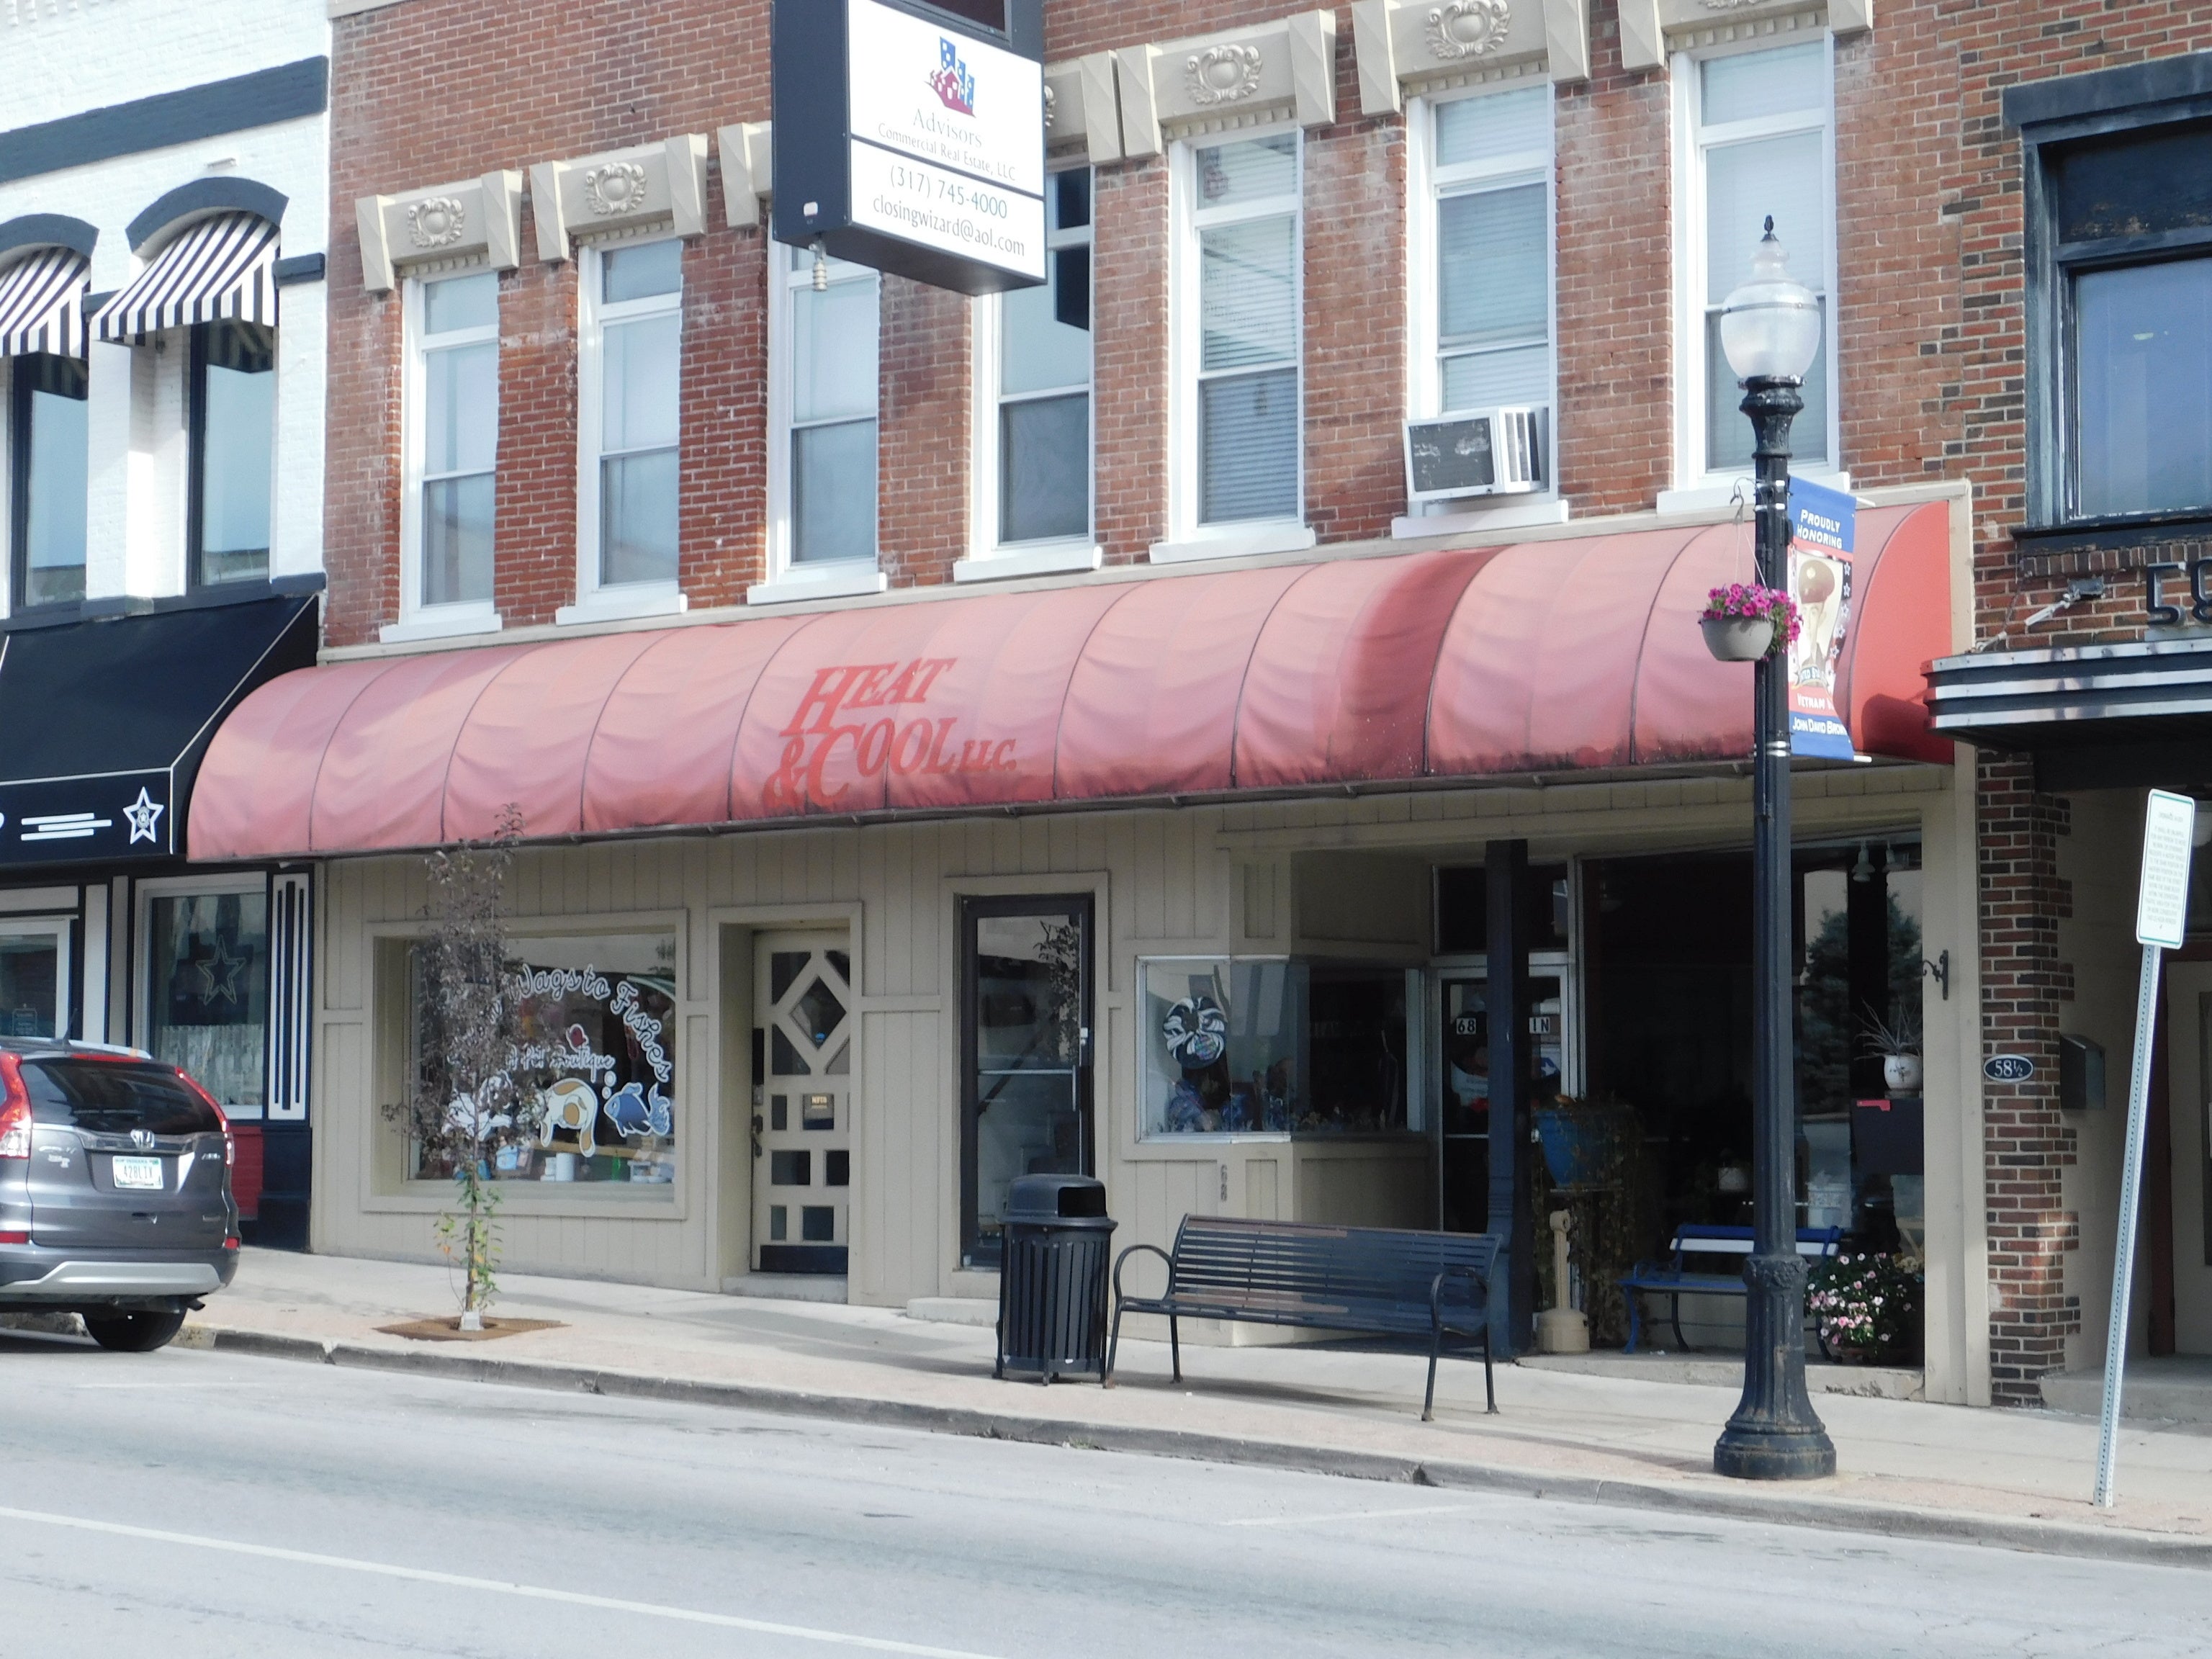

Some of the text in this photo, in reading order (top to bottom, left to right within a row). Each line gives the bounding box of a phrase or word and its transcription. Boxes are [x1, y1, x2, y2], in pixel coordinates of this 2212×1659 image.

[878, 122, 1015, 181] Commercial Real Estate, LLC
[912, 108, 982, 148] Advisors
[890, 165, 1007, 219] (317) 745-4000
[873, 194, 1025, 256] closingwizard@aol.com
[1797, 523, 1843, 549] HONORING
[1801, 508, 1841, 534] PROUDLY
[778, 657, 958, 737] HEAT
[1807, 718, 1827, 734] DAVID
[806, 717, 958, 808] COOL
[508, 963, 673, 1083] Wags to Fishes
[1457, 1019, 1475, 1033] 68
